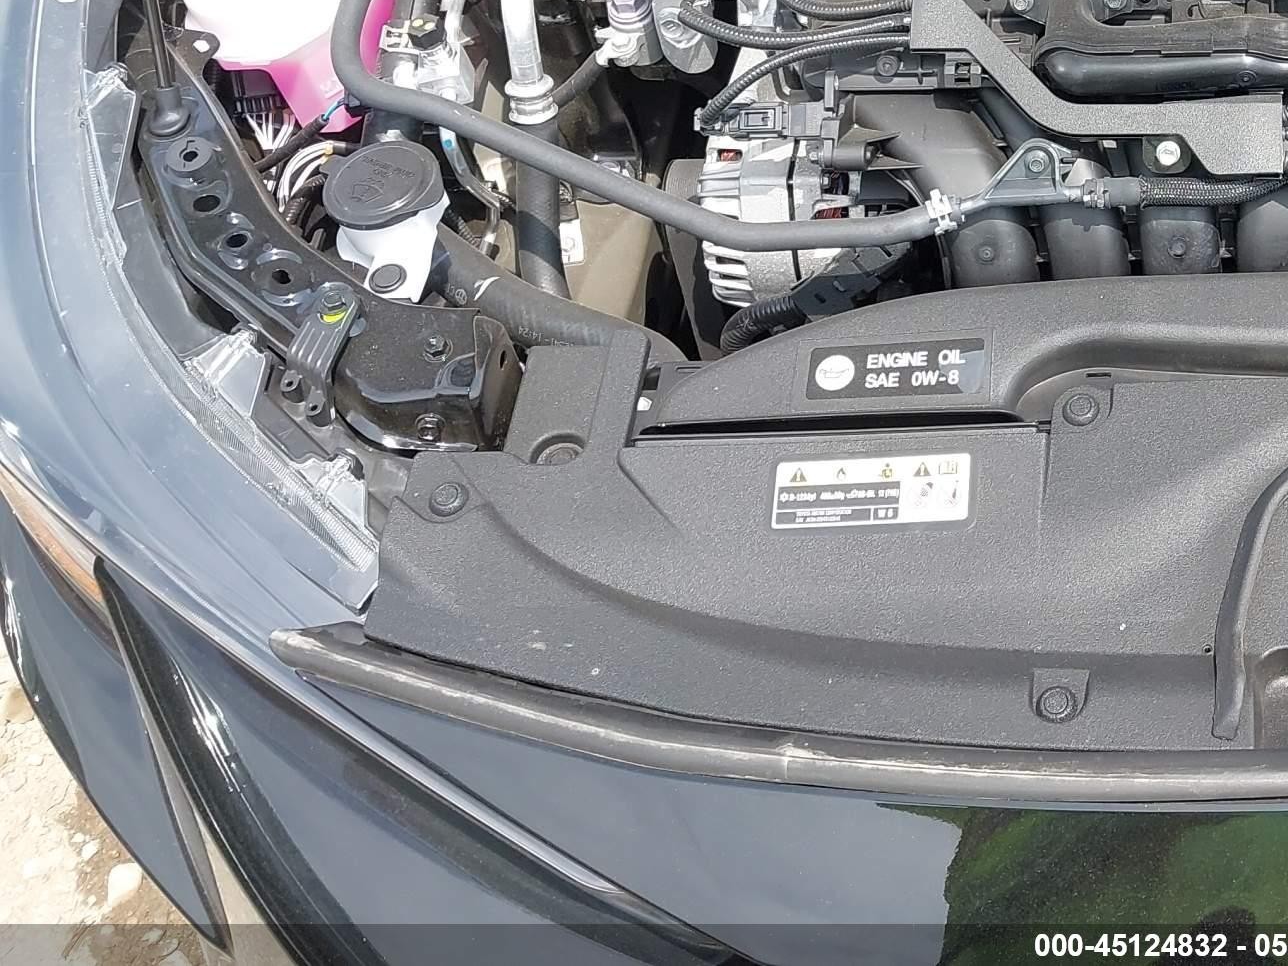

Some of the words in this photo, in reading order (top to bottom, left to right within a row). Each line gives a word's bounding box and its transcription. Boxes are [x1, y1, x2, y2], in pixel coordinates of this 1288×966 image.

[866, 350, 929, 370] ENGINE
[938, 348, 967, 365] OIL
[864, 371, 900, 389] SAE
[911, 369, 960, 388] 0W-8
